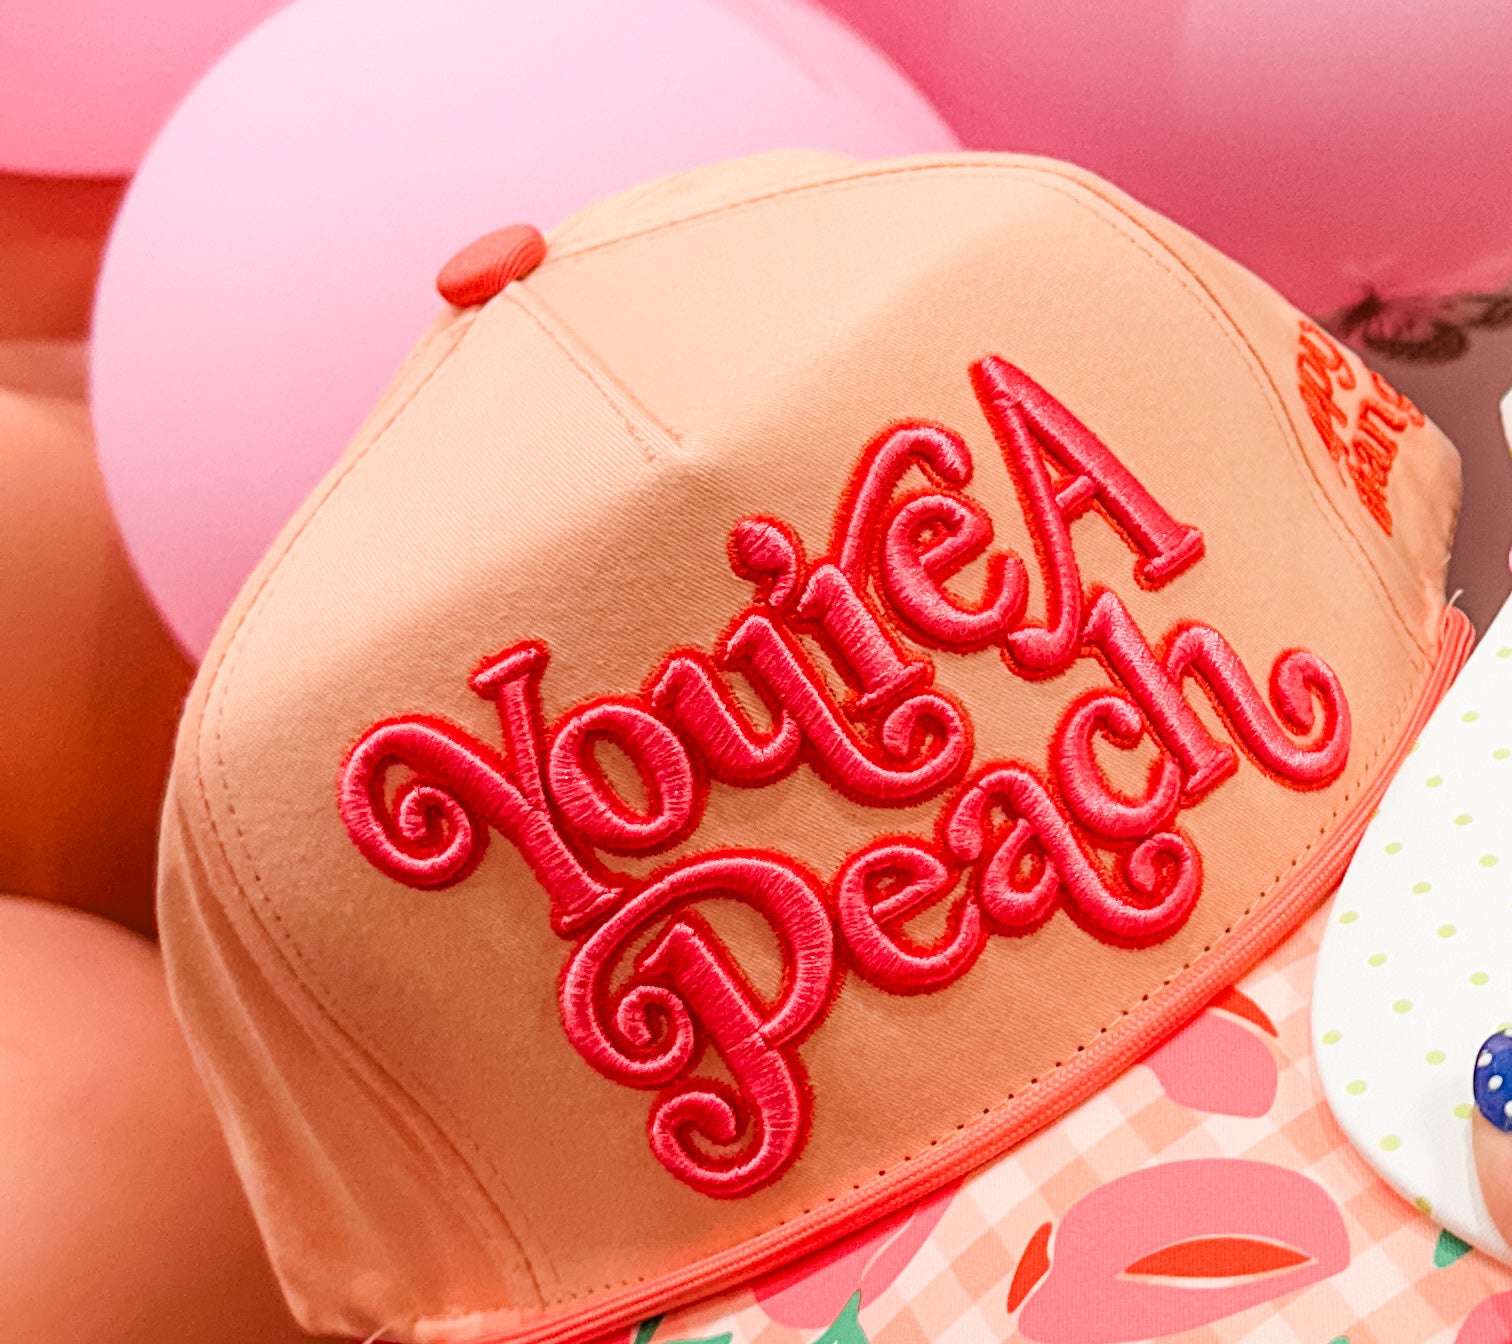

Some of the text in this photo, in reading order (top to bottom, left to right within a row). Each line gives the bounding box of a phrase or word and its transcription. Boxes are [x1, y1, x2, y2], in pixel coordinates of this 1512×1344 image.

[337, 354, 1205, 938] You're A
[558, 584, 1352, 1199] Peach
